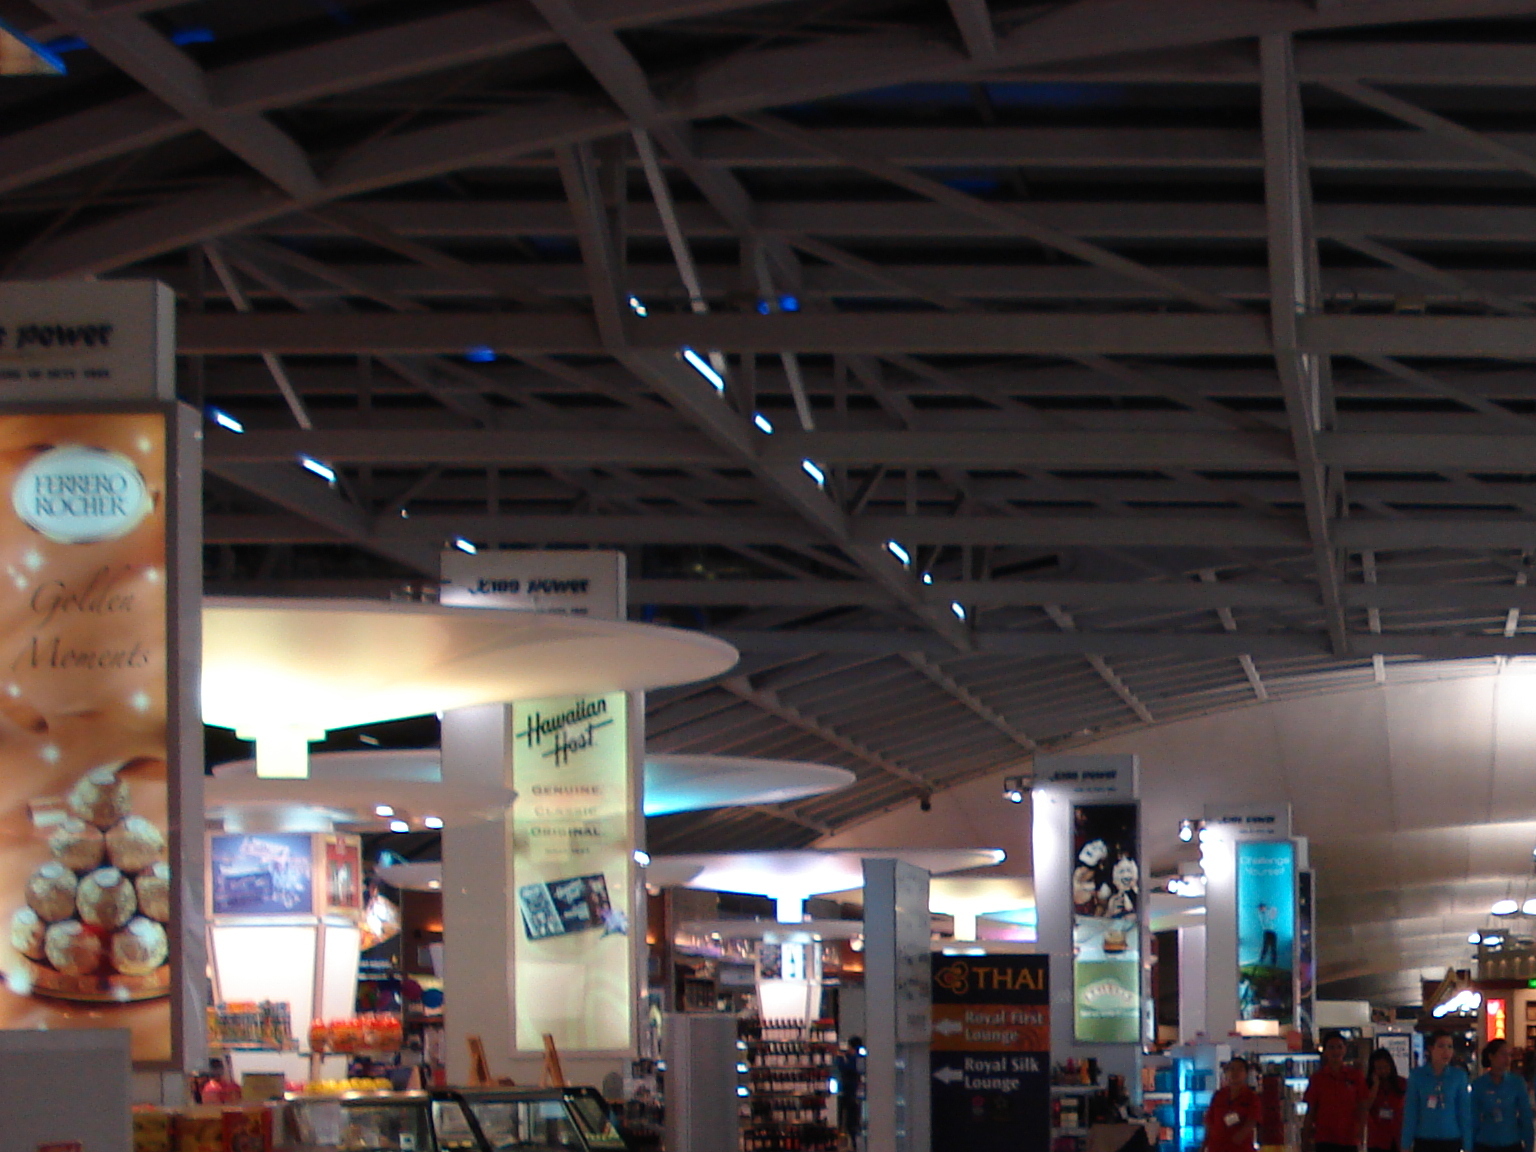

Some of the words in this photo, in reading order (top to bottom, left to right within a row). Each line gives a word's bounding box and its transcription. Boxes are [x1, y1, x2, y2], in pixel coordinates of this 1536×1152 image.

[35, 473, 127, 494] FERRERO
[35, 497, 127, 516] ROCHER
[30, 566, 134, 629] Golden
[12, 637, 149, 671] Moments
[518, 698, 607, 747] Hawaiian
[544, 720, 606, 767] Host
[531, 785, 600, 796] GENUINE
[530, 826, 601, 837] ORIGINAL
[971, 967, 1045, 990] THAI
[964, 1010, 1007, 1027] Royal
[1010, 1010, 1044, 1026] First
[964, 1028, 1019, 1046] Lounge
[964, 1057, 1007, 1073] Royal
[1010, 1057, 1040, 1073] Silk
[964, 1076, 1020, 1092] Lounge
